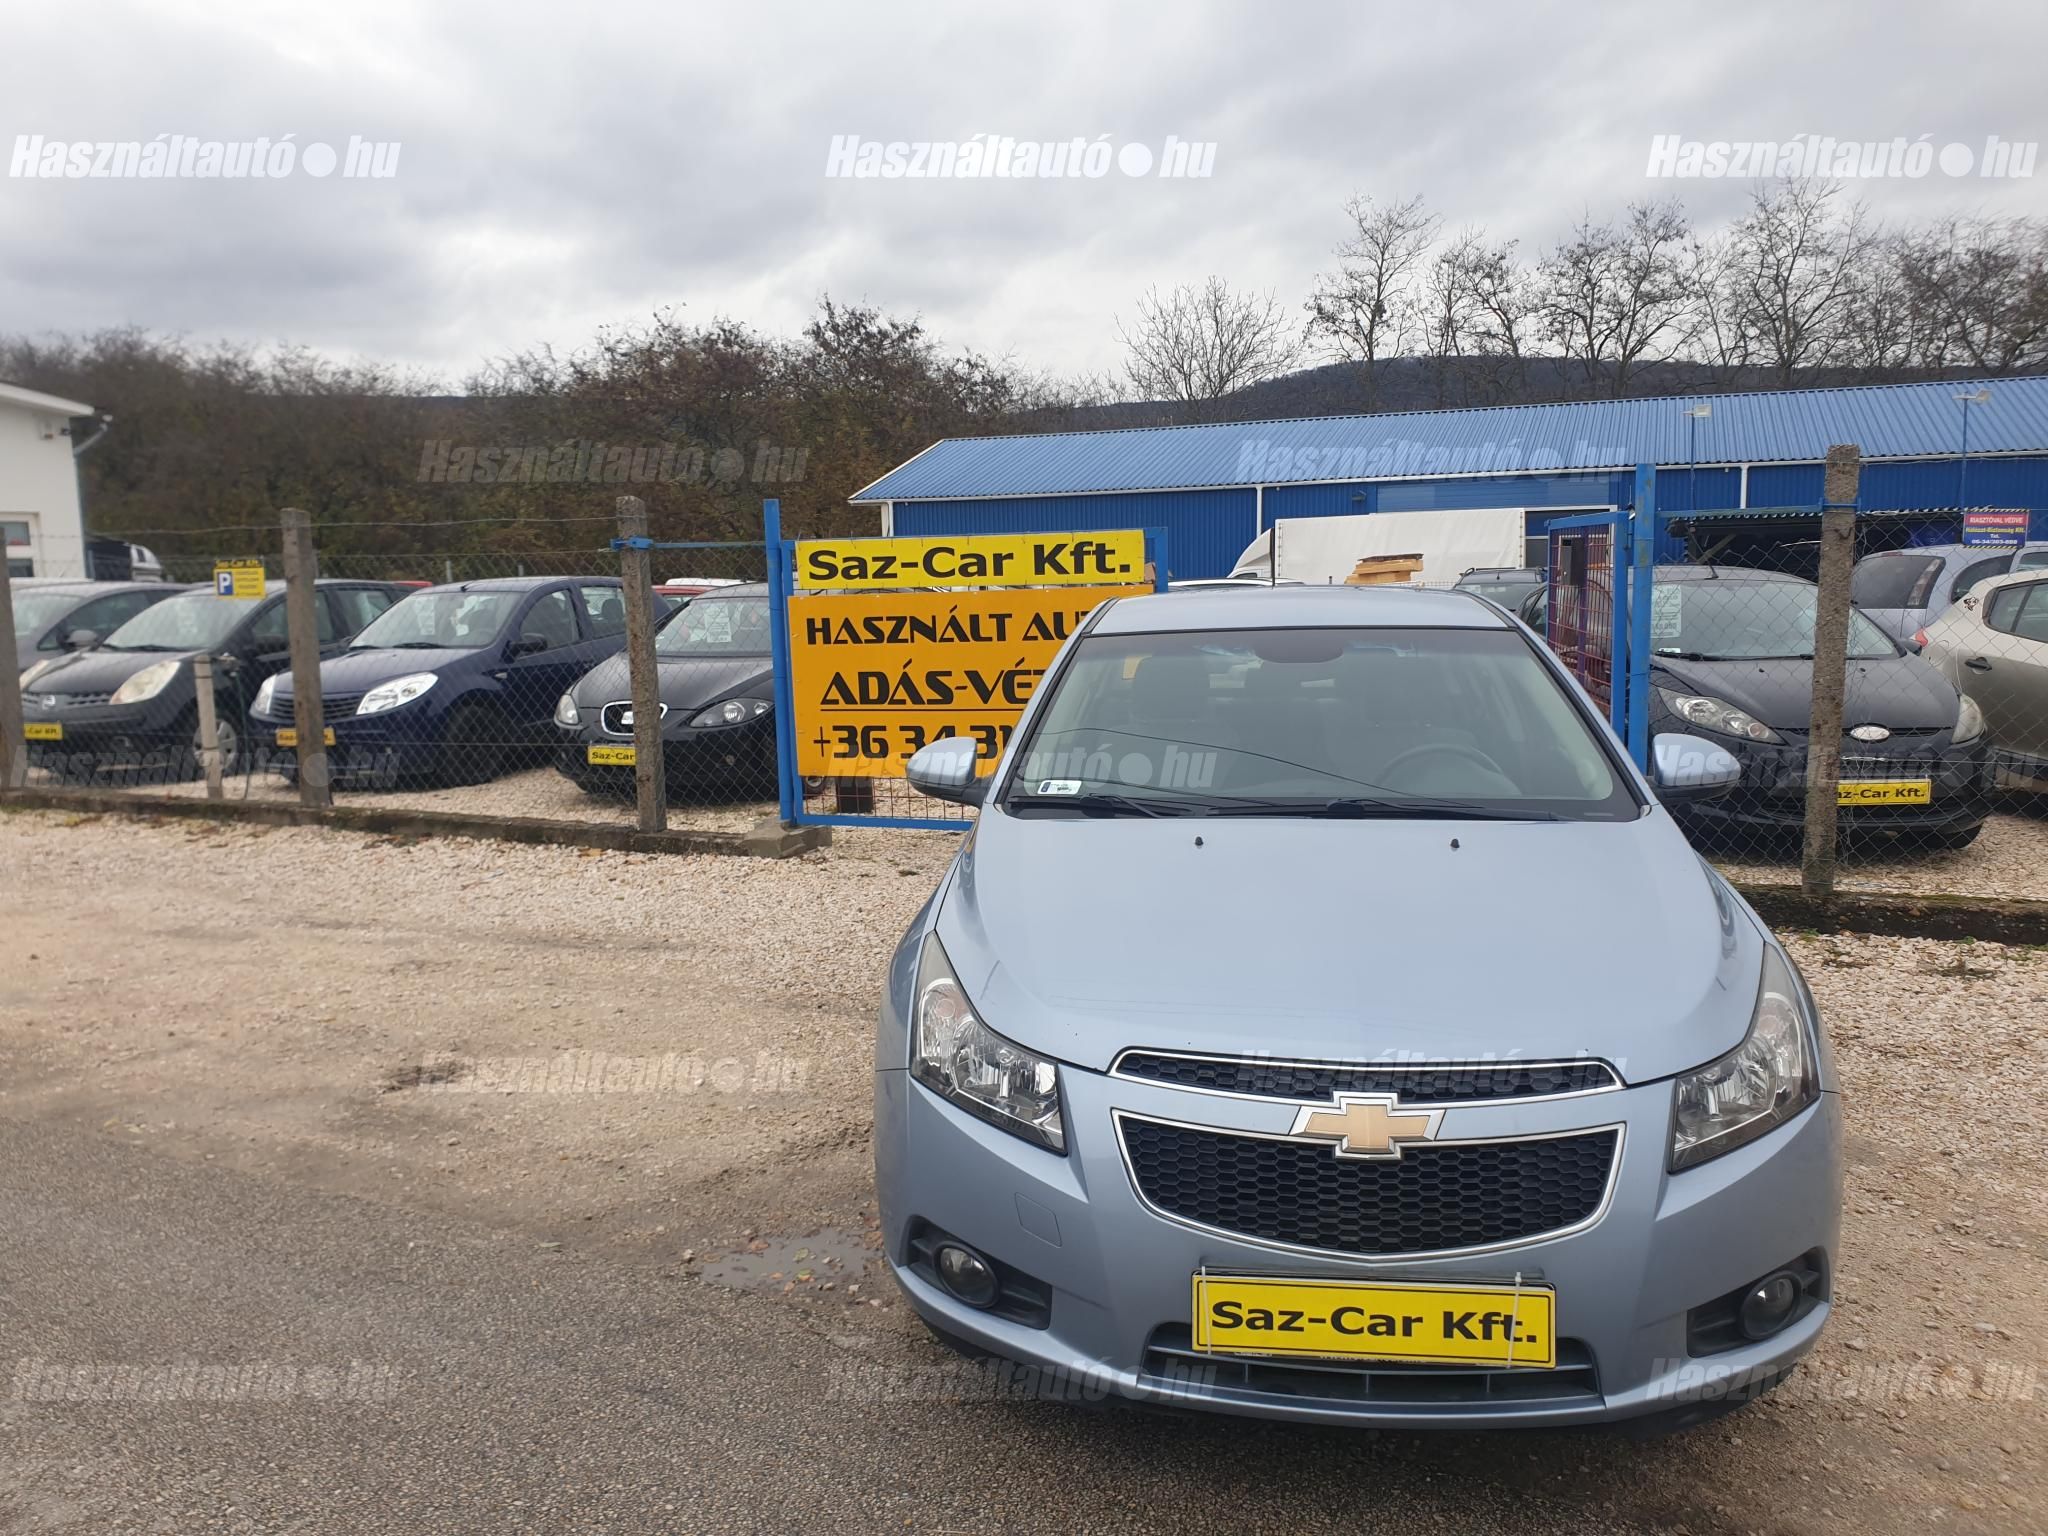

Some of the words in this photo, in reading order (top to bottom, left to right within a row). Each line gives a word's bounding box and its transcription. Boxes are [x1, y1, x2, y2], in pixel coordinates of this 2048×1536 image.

[808, 546, 1014, 580] Saz-Car
[1033, 541, 1131, 576] Kft.
[806, 605, 1013, 645] HASZNÁLT
[1022, 611, 1091, 641] AU
[820, 656, 1047, 705] ADÁS-VÉ
[591, 751, 635, 761] Saz-Car
[813, 725, 889, 759] +36
[1837, 789, 1890, 799] az-Car
[1895, 787, 1925, 798] Kft.
[1211, 1300, 1424, 1337] Saz-Car
[1442, 1311, 1537, 1344] Kft.
